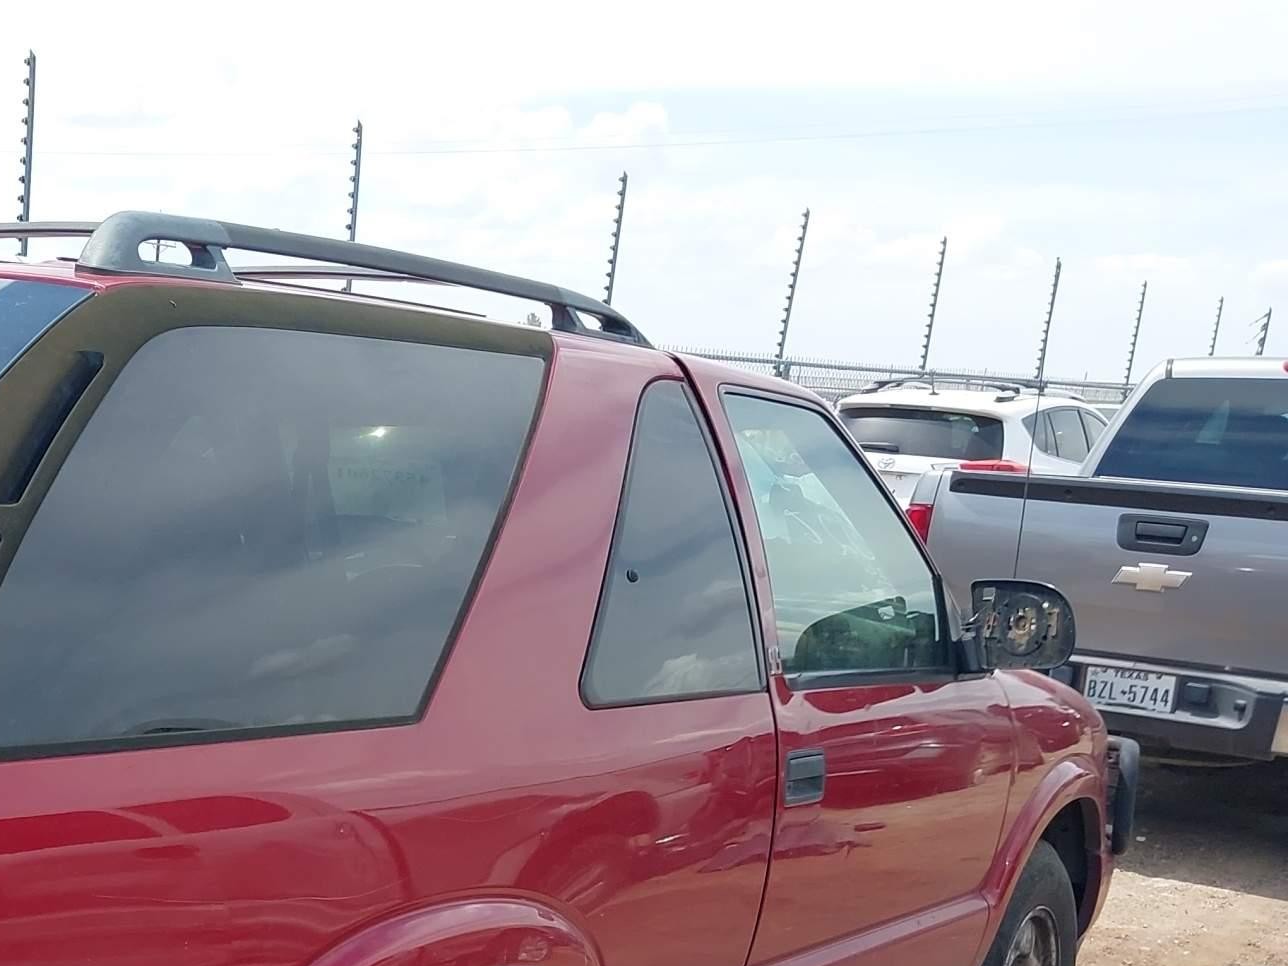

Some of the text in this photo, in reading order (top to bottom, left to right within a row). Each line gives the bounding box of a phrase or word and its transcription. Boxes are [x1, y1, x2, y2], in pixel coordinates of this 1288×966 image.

[1114, 669, 1149, 681] TEXAS
[1088, 680, 1171, 708] BZL 5744
